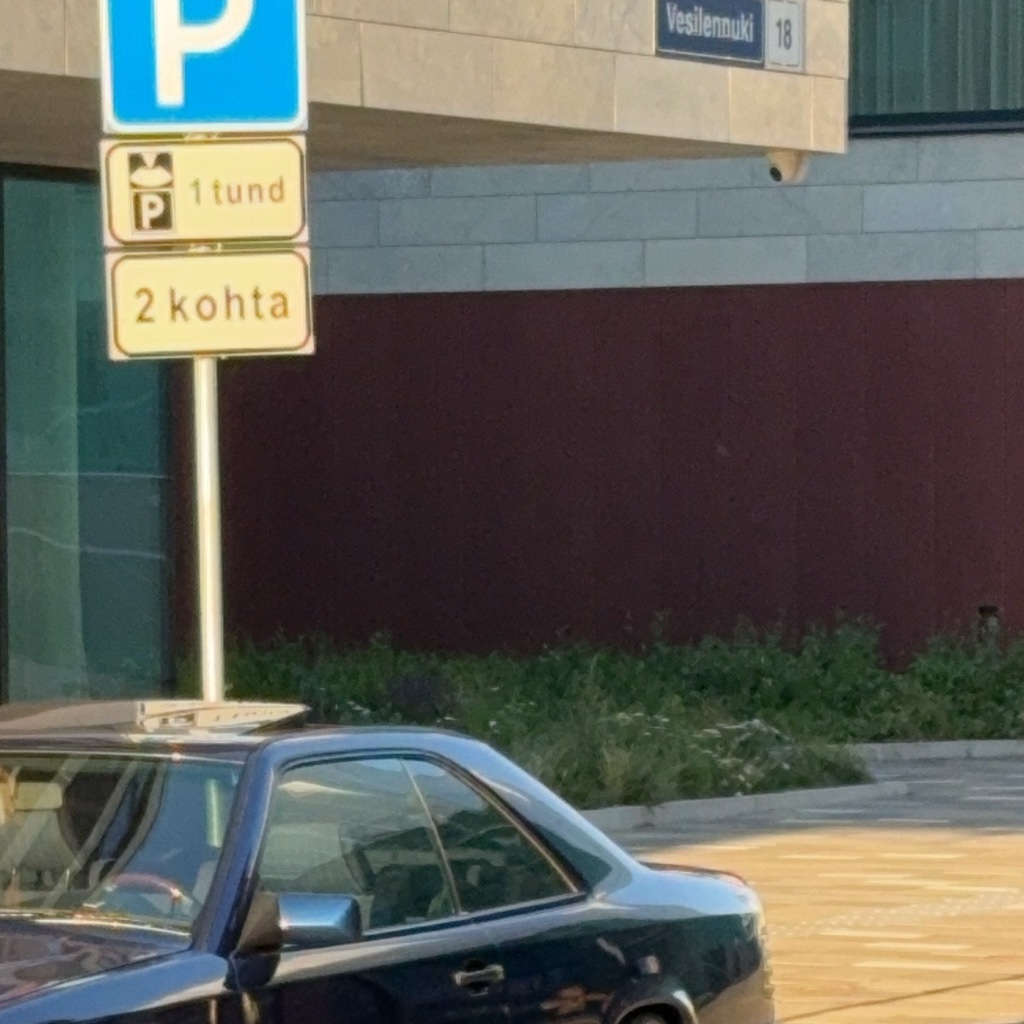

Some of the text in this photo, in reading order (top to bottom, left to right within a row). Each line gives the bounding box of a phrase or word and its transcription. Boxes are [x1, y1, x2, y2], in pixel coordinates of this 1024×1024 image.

[666, 2, 755, 43] Vesilennuki
[776, 18, 793, 50] 18
[153, 0, 255, 108] P
[189, 176, 286, 205] 1 tund
[141, 194, 164, 230] P
[134, 285, 291, 323] 2 kohta
